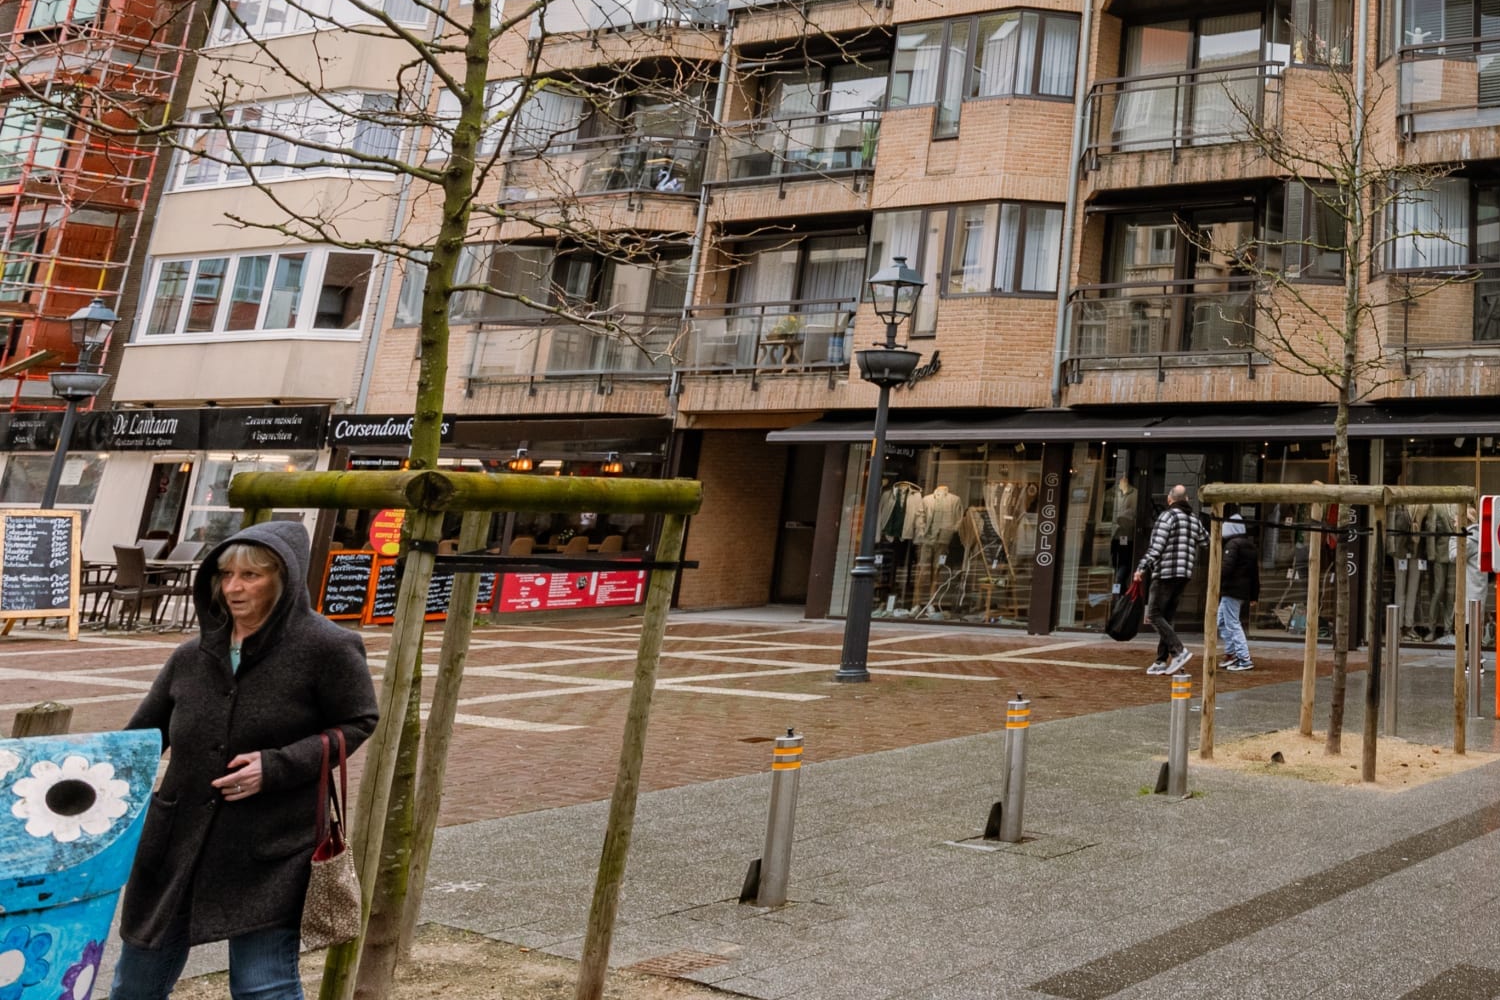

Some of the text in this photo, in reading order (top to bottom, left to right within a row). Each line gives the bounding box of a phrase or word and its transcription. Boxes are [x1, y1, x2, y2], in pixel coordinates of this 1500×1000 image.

[113, 413, 179, 435] De Lantaarn
[335, 417, 414, 439] Corsendonk
[1036, 472, 1059, 566] GIGOLO
